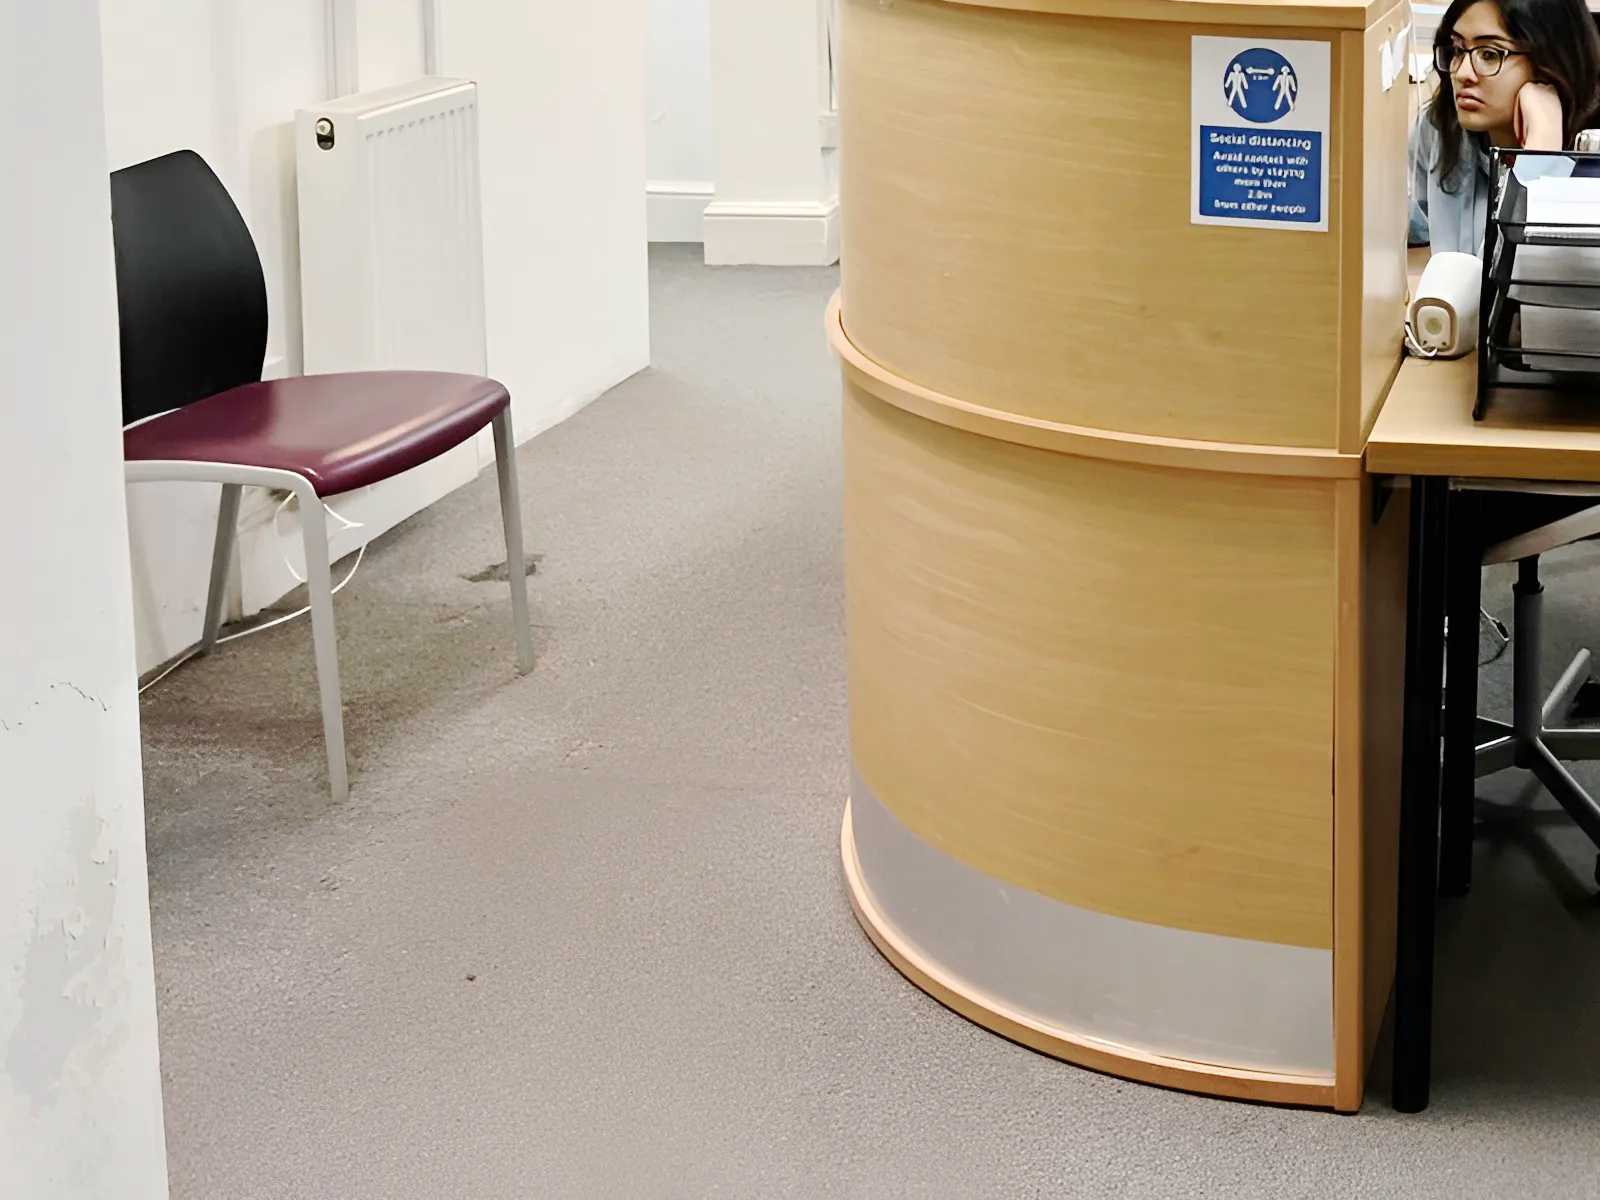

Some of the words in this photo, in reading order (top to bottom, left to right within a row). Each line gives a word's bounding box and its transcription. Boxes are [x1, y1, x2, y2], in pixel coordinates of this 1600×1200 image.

[1209, 132, 1246, 146] Social
[1248, 134, 1312, 151] distancing
[1213, 150, 1243, 162] Avoid
[1244, 154, 1284, 165] contact
[1286, 156, 1309, 166] with
[1216, 164, 1248, 174] others
[1251, 166, 1264, 176] by
[1267, 167, 1305, 180] staying
[1241, 202, 1268, 212] other
